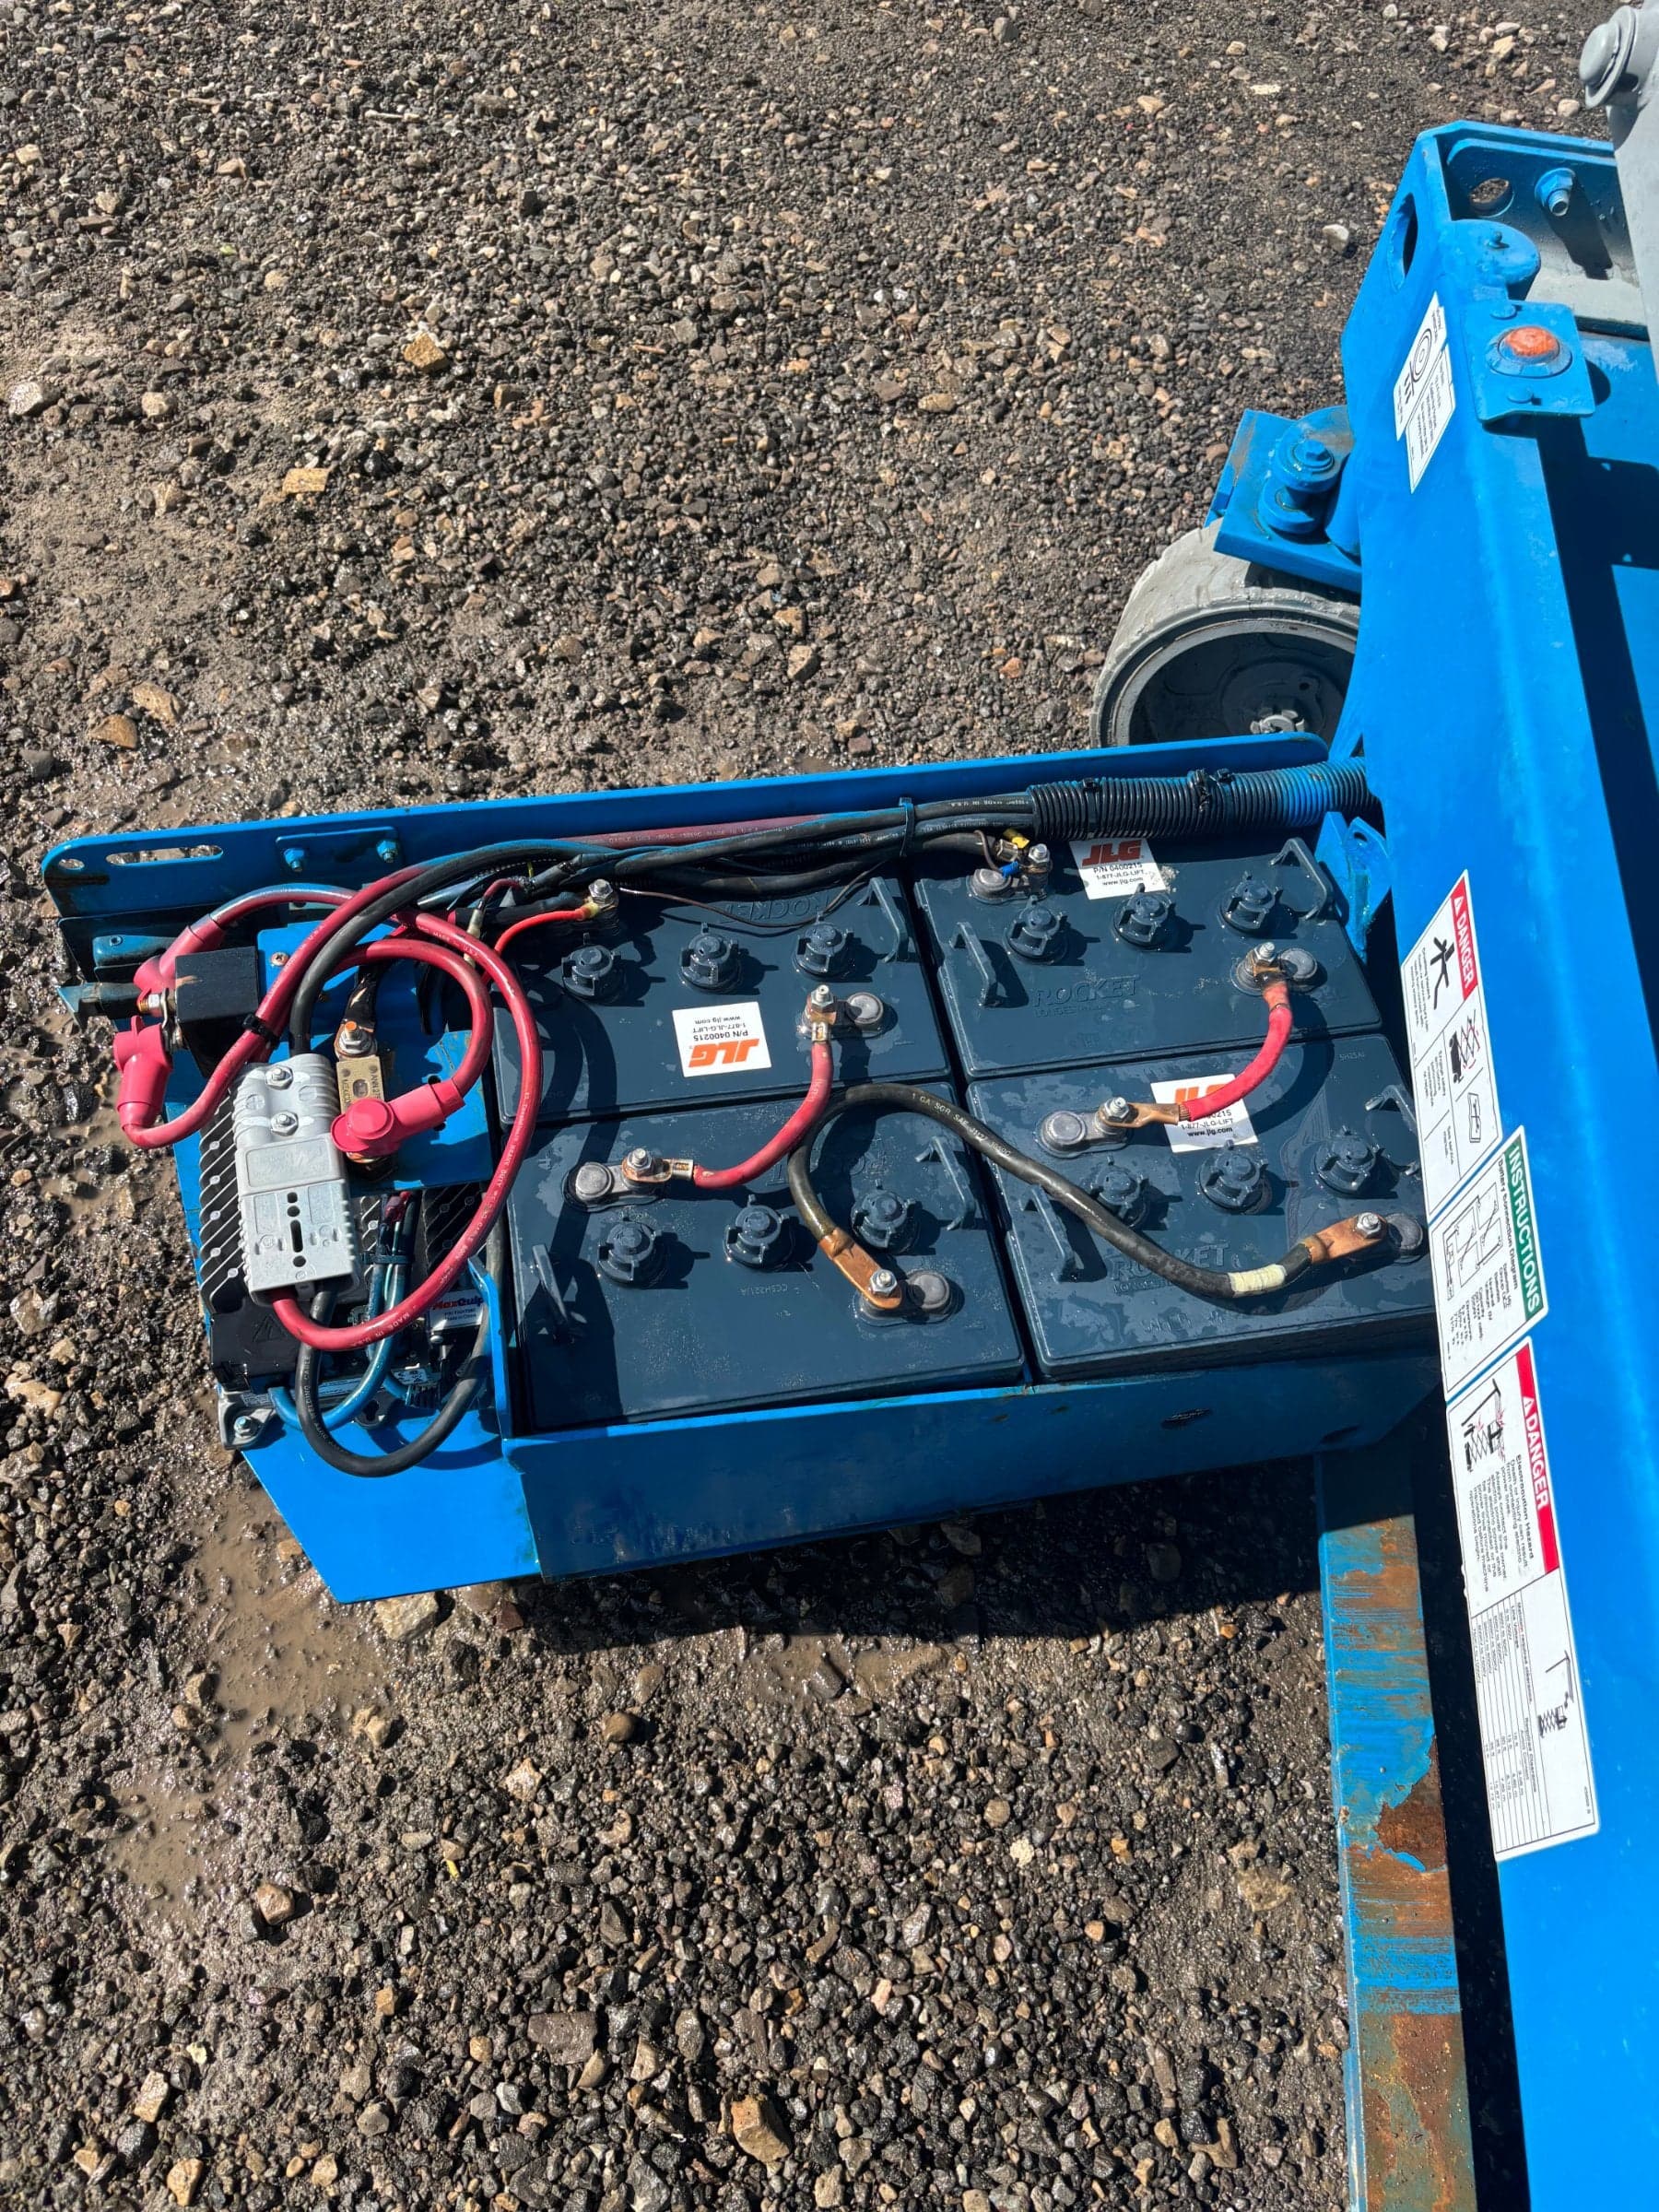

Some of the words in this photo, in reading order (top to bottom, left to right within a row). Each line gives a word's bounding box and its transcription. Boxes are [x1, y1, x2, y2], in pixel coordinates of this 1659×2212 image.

[1081, 841, 1143, 866] JLG
[1095, 869, 1145, 879] 1-877-JLG-LIFT
[1108, 862, 1143, 871] 0400215
[1101, 877, 1144, 887] www.jlg.com
[1456, 912, 1473, 989] DANGER
[1031, 974, 1139, 1007] ROCKET
[692, 1022, 746, 1032] 1-877-JLG-LIFT
[693, 1015, 740, 1024] www.jlg.com
[692, 1030, 730, 1041] 0400215
[688, 1038, 759, 1067] JLG
[919, 1096, 931, 1106] GA
[934, 1102, 952, 1115] SGR
[1181, 1117, 1234, 1130] 1-877-JLG-LIFT
[1186, 1126, 1233, 1138] www.jlg.com
[1508, 1145, 1540, 1312] INSTRUCTIONS
[1503, 1194, 1512, 1246] Connection
[1510, 1248, 1518, 1289] Diagram
[302, 1355, 312, 1381] CABLE
[303, 1383, 317, 1421] WELDING
[1525, 1415, 1549, 1511] DANGER
[1516, 1454, 1528, 1520] Electrocution
[1525, 1523, 1534, 1559] Hazard
